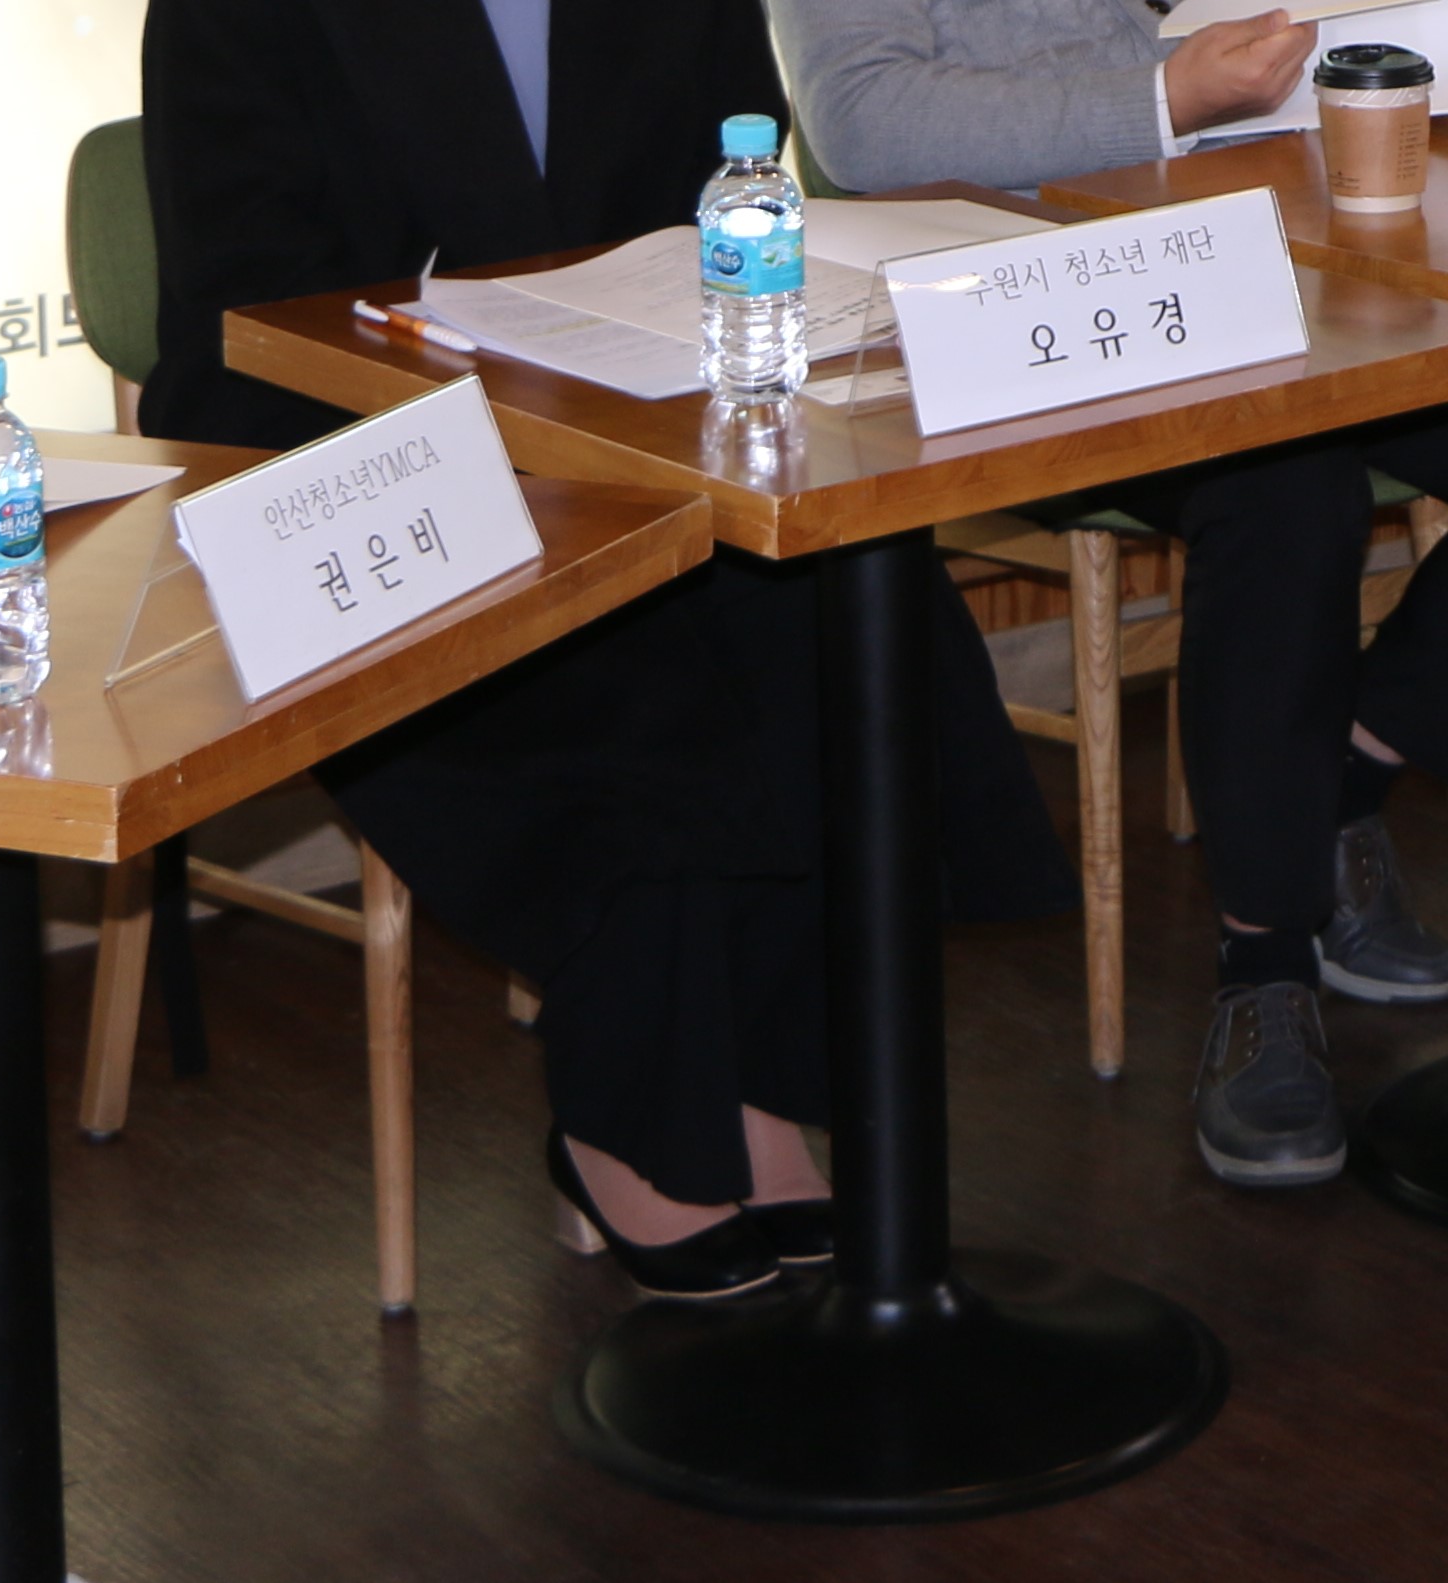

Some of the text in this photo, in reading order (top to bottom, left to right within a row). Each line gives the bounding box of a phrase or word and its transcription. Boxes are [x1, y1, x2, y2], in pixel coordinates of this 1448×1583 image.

[1064, 239, 1149, 286] 청소년
[1160, 225, 1216, 265] 재단
[1028, 292, 1188, 367] 오 유 경
[264, 435, 441, 541] 안산청소년YMCA
[314, 508, 450, 613] 권 은 비
